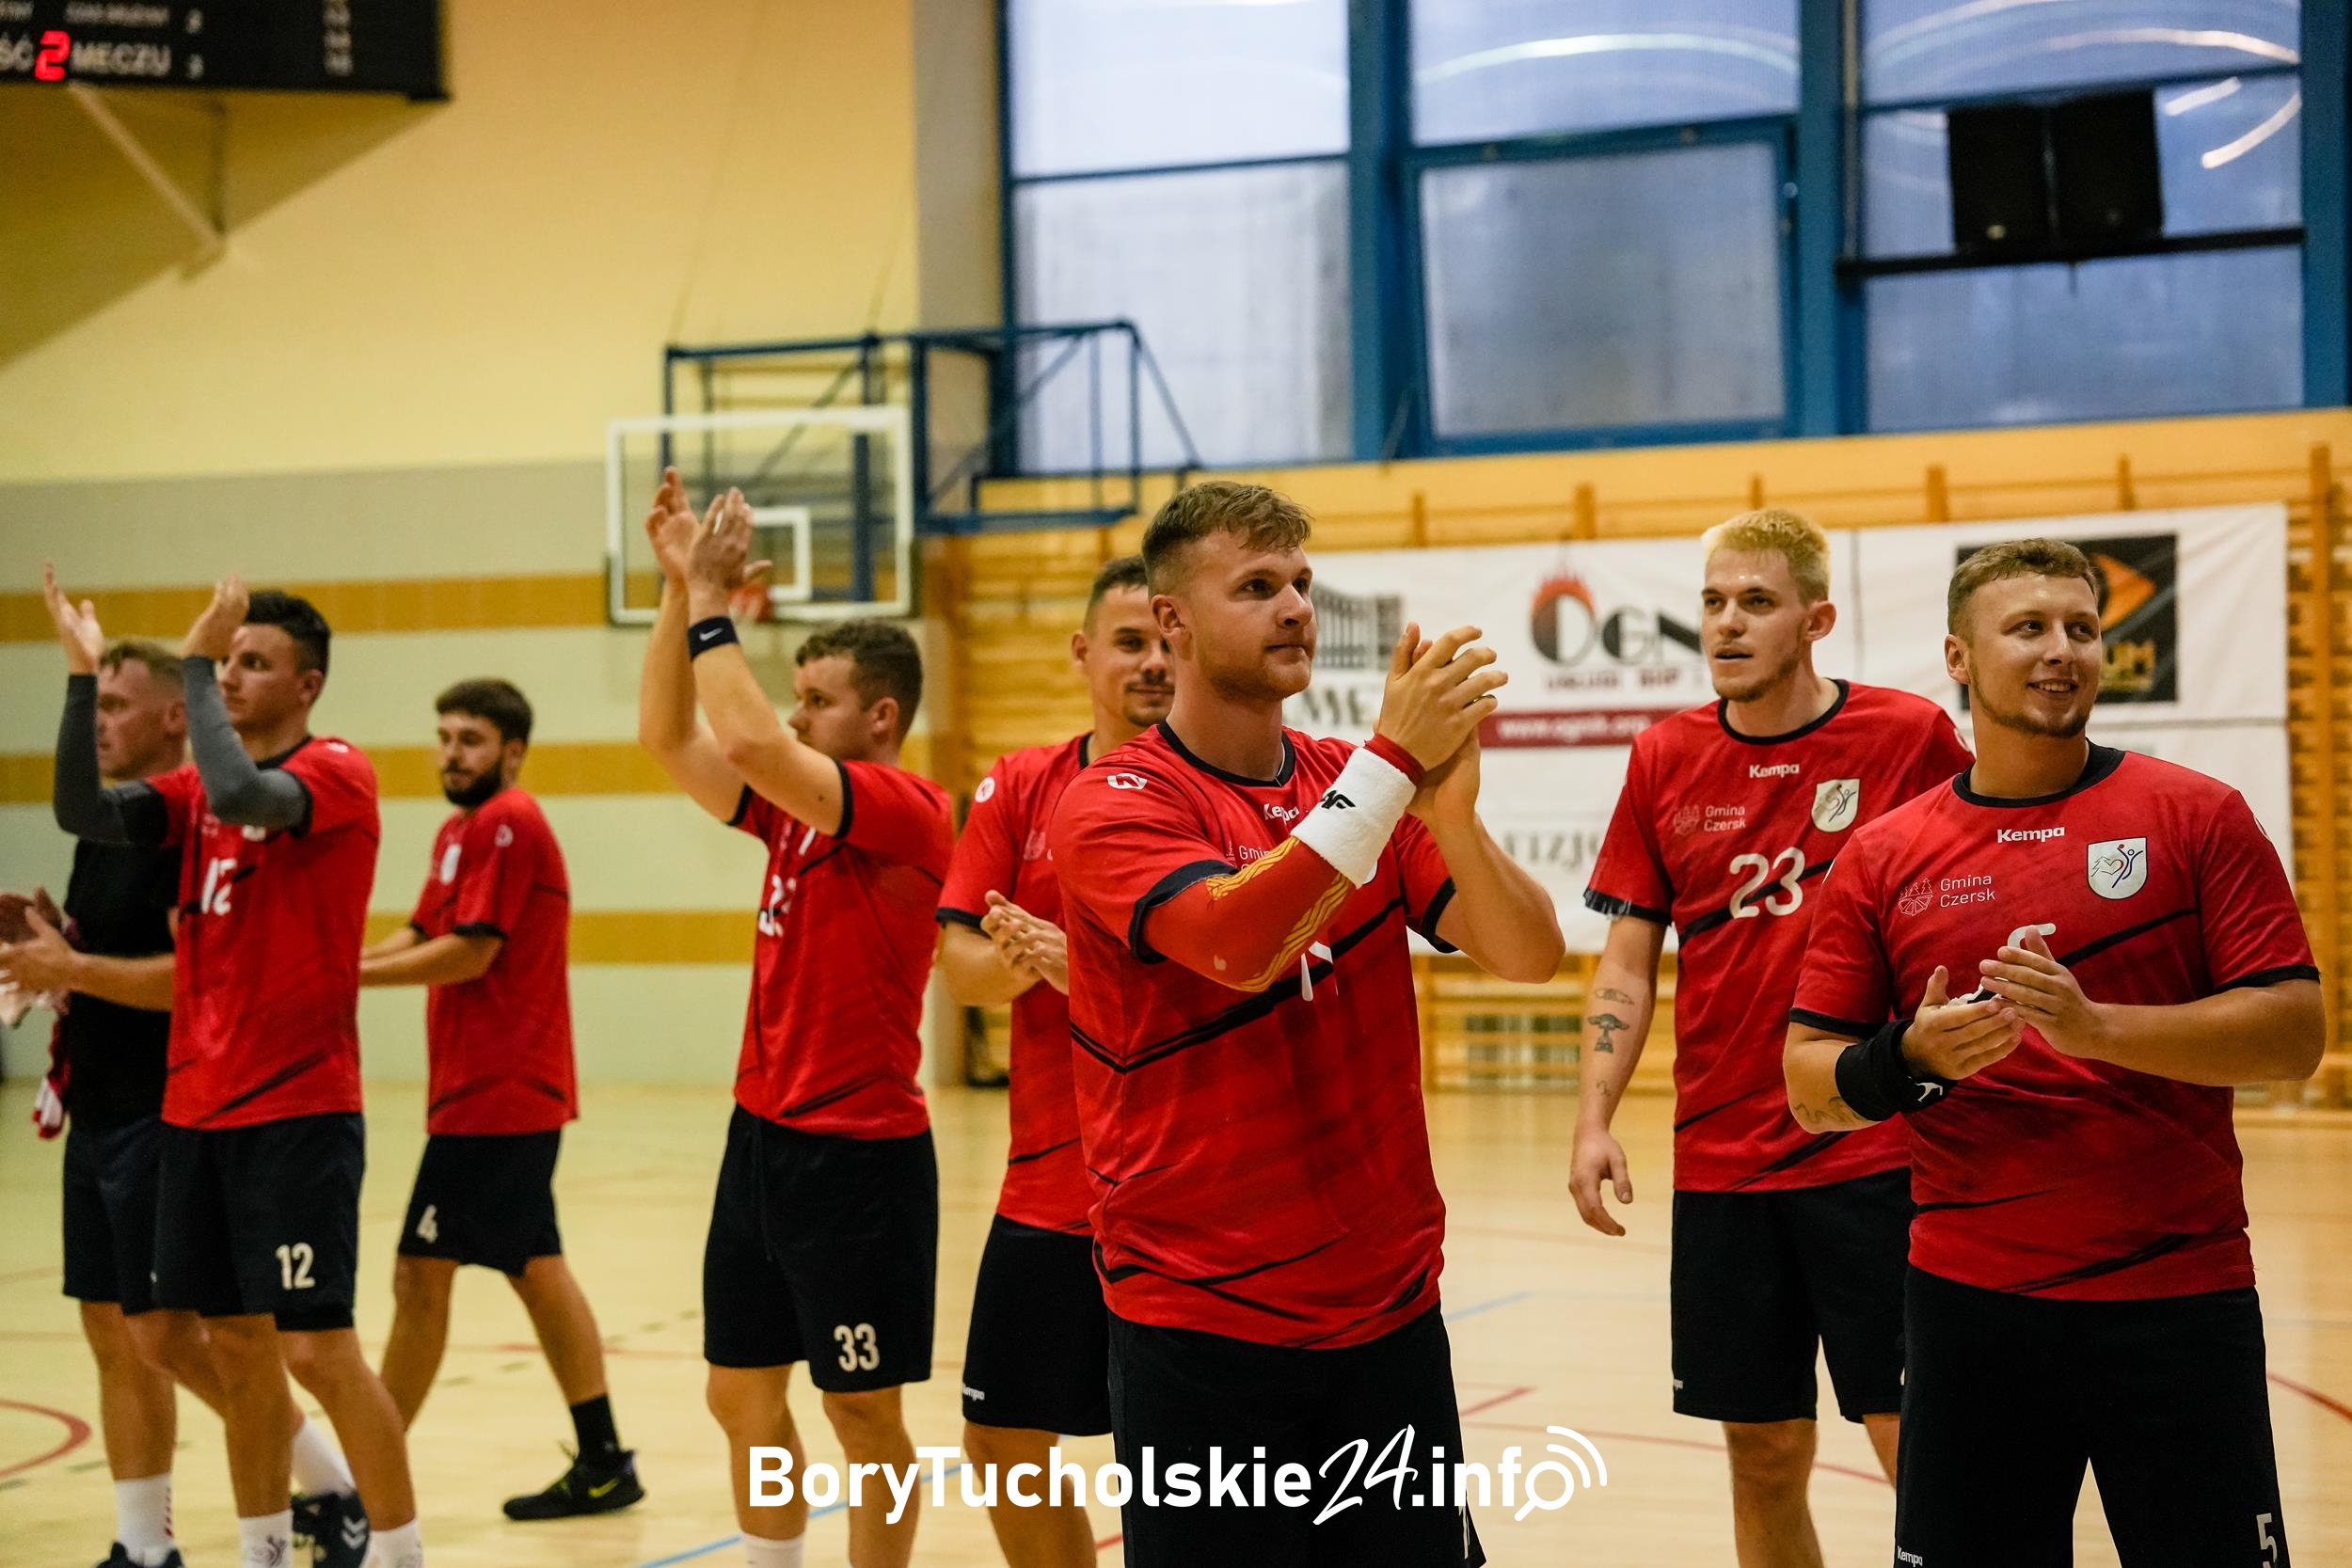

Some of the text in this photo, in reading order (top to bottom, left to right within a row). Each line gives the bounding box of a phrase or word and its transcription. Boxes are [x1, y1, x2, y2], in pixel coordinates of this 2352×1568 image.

[35, 30, 71, 81] 2
[1749, 764, 1800, 779] Kempa
[1263, 803, 1300, 825] Kepa
[1705, 803, 1745, 818] Gmina
[1704, 818, 1747, 832] Czersk
[1996, 827, 2066, 844] Kempa
[1729, 847, 1805, 919] 23
[1940, 875, 1993, 892] Gmina
[1940, 888, 1996, 908] Czersk
[416, 1204, 438, 1243] 4
[275, 1242, 316, 1291] 12
[834, 1323, 881, 1371] 33
[2256, 1512, 2278, 1568] 5
